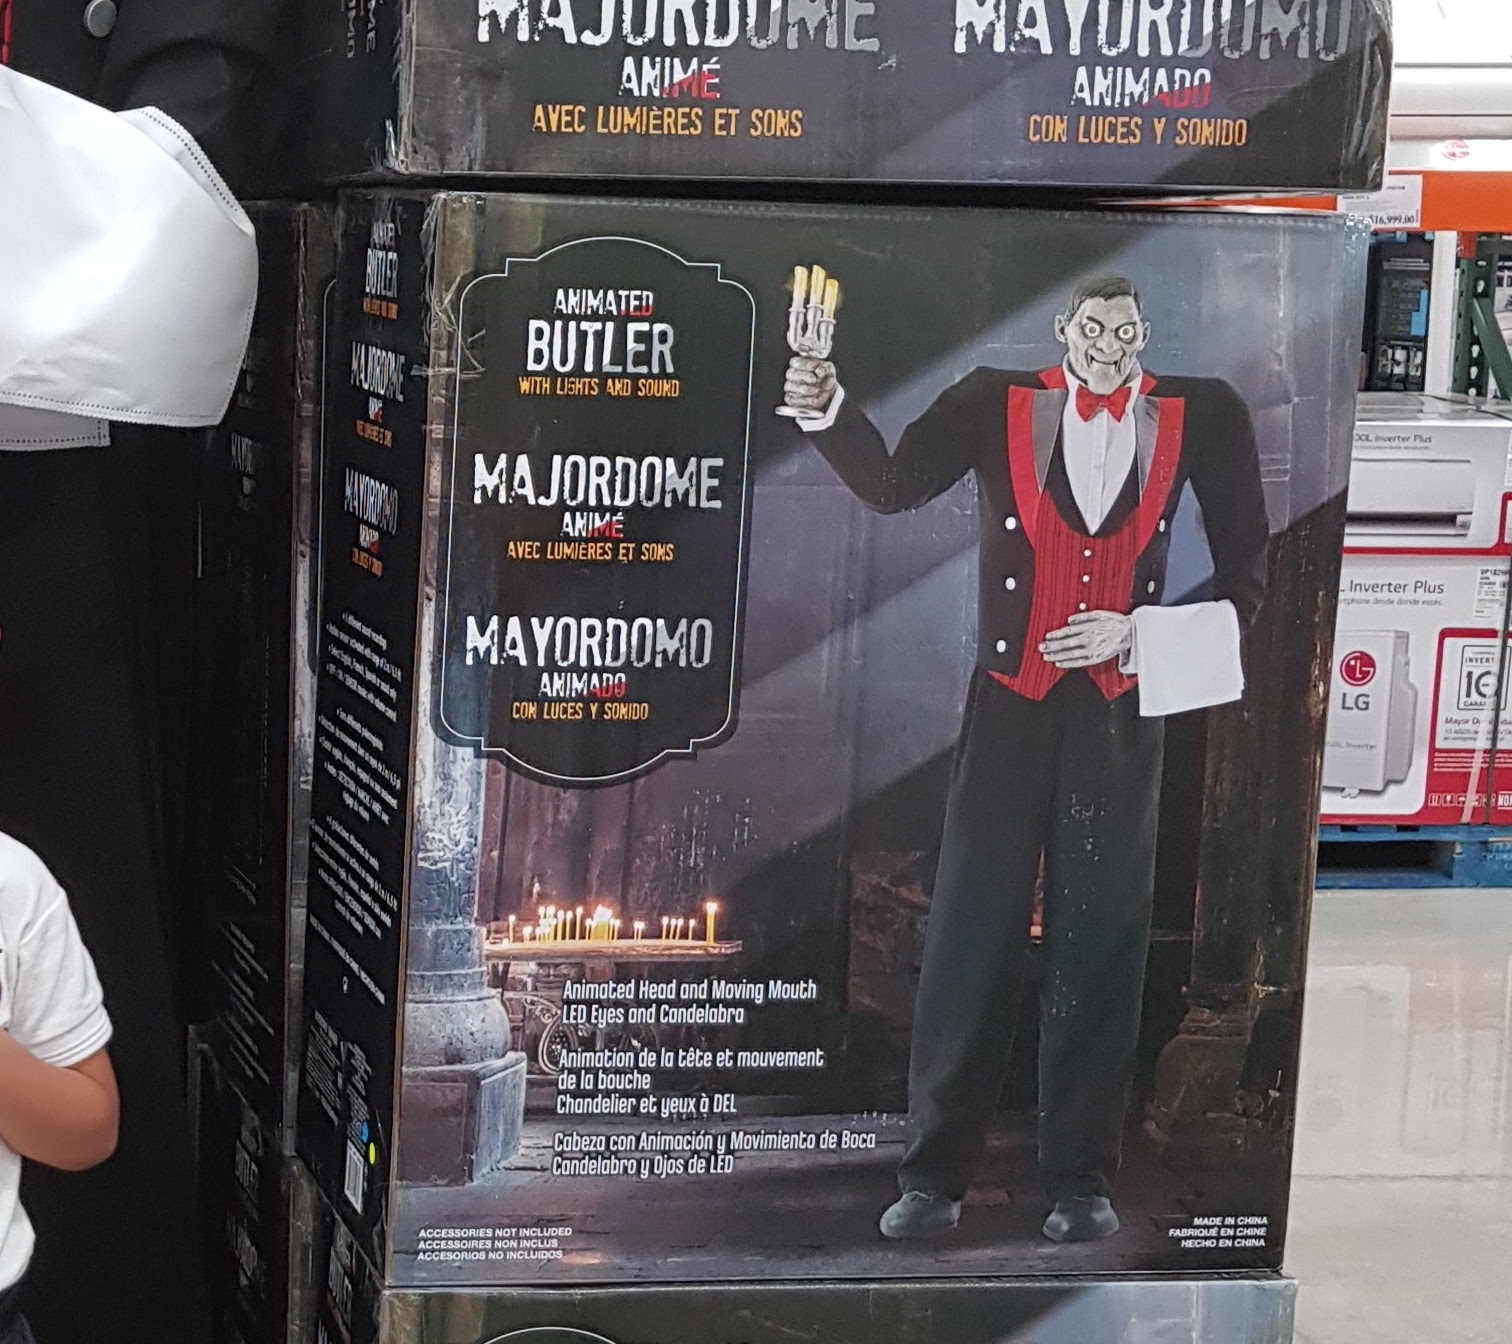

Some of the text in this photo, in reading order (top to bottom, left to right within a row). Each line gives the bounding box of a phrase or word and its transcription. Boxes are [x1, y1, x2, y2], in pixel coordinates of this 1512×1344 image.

[617, 54, 720, 99] ANIMÉ
[1070, 65, 1212, 107] ANIMADO
[532, 100, 802, 137] AVEC LUMIÈRES ET SONS
[1028, 112, 1246, 145] CON LUCES Y SONIDO
[554, 289, 653, 316] ANIMATED
[527, 319, 674, 373] BUTLER
[519, 377, 680, 397] WITH LIGHTS AND SOUND
[473, 454, 723, 508] MAJORDOME
[561, 510, 623, 538] ANIMÉ
[507, 539, 674, 560] AVEC LUMIÈRES ET SONS
[1350, 580, 1444, 594] Inverter Plus
[465, 616, 712, 667] MAYORDOMO
[539, 673, 626, 697] ANIMADO
[512, 702, 648, 720] CON LUCES Y SONIDO
[1341, 693, 1370, 711] LG
[563, 979, 817, 1004] Animated Head and Moving Mouth
[562, 1004, 744, 1027] LED Eyes and Candelabra
[559, 1047, 824, 1068] Animation de la tête et mouvement
[558, 1070, 651, 1090] de la bouche
[557, 1094, 737, 1117] Chandelier et yeux à DEL
[554, 1130, 876, 1154] Cabeza con Animación y Movimiento de Boca
[552, 1155, 733, 1178] Candelabro y Ojos de LED
[419, 1227, 572, 1237] ACCESSORIES NOT INCLUDED
[1194, 1217, 1268, 1225] MADE IN CHINA
